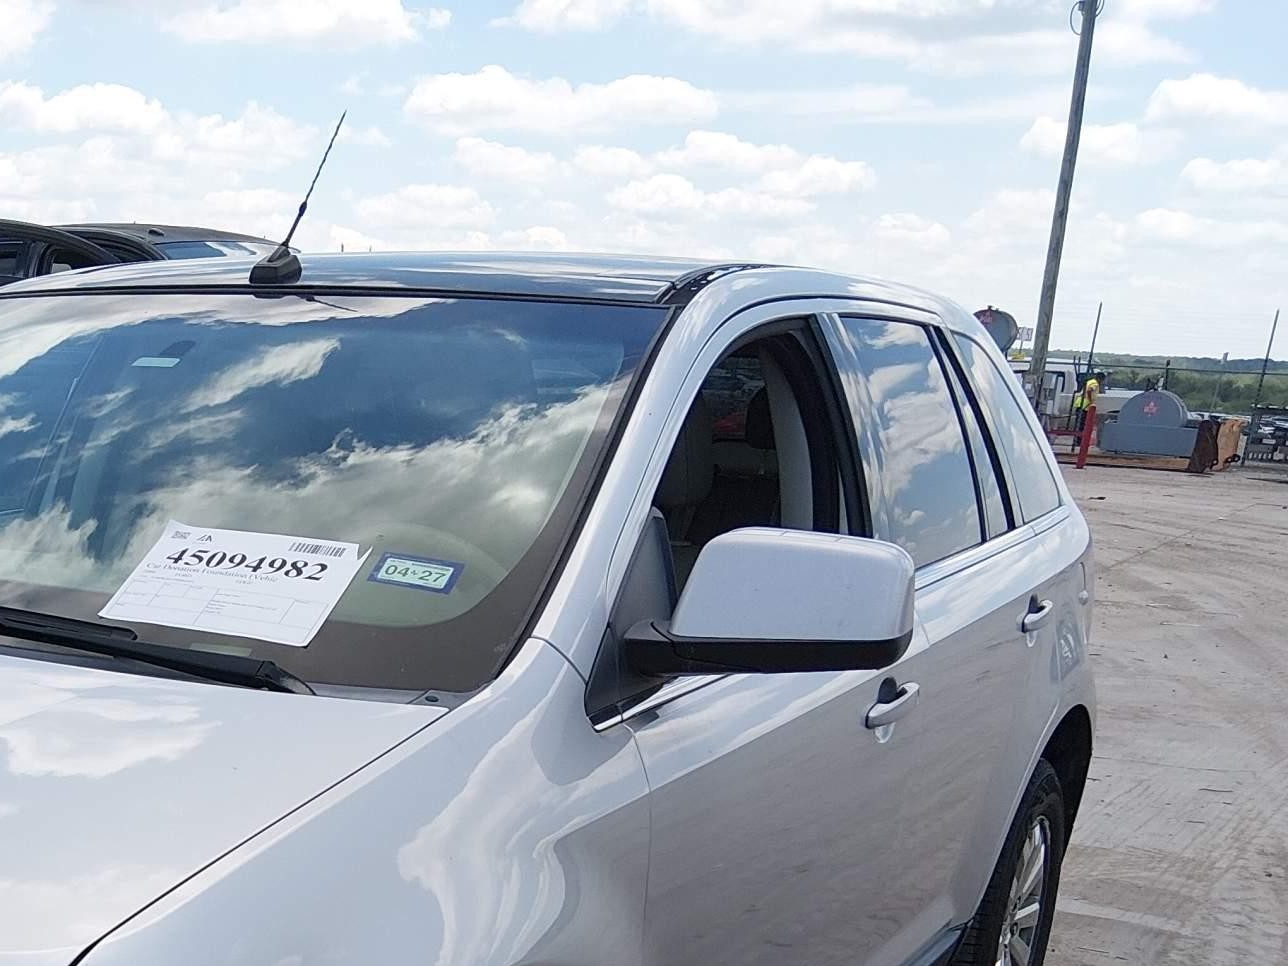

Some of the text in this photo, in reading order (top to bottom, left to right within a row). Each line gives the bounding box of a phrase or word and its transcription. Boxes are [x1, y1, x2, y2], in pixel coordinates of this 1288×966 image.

[163, 563, 200, 574] Donation
[201, 568, 247, 579] Foundation
[166, 547, 329, 582] 45094982
[384, 564, 410, 577] 04
[418, 569, 447, 583] 27
